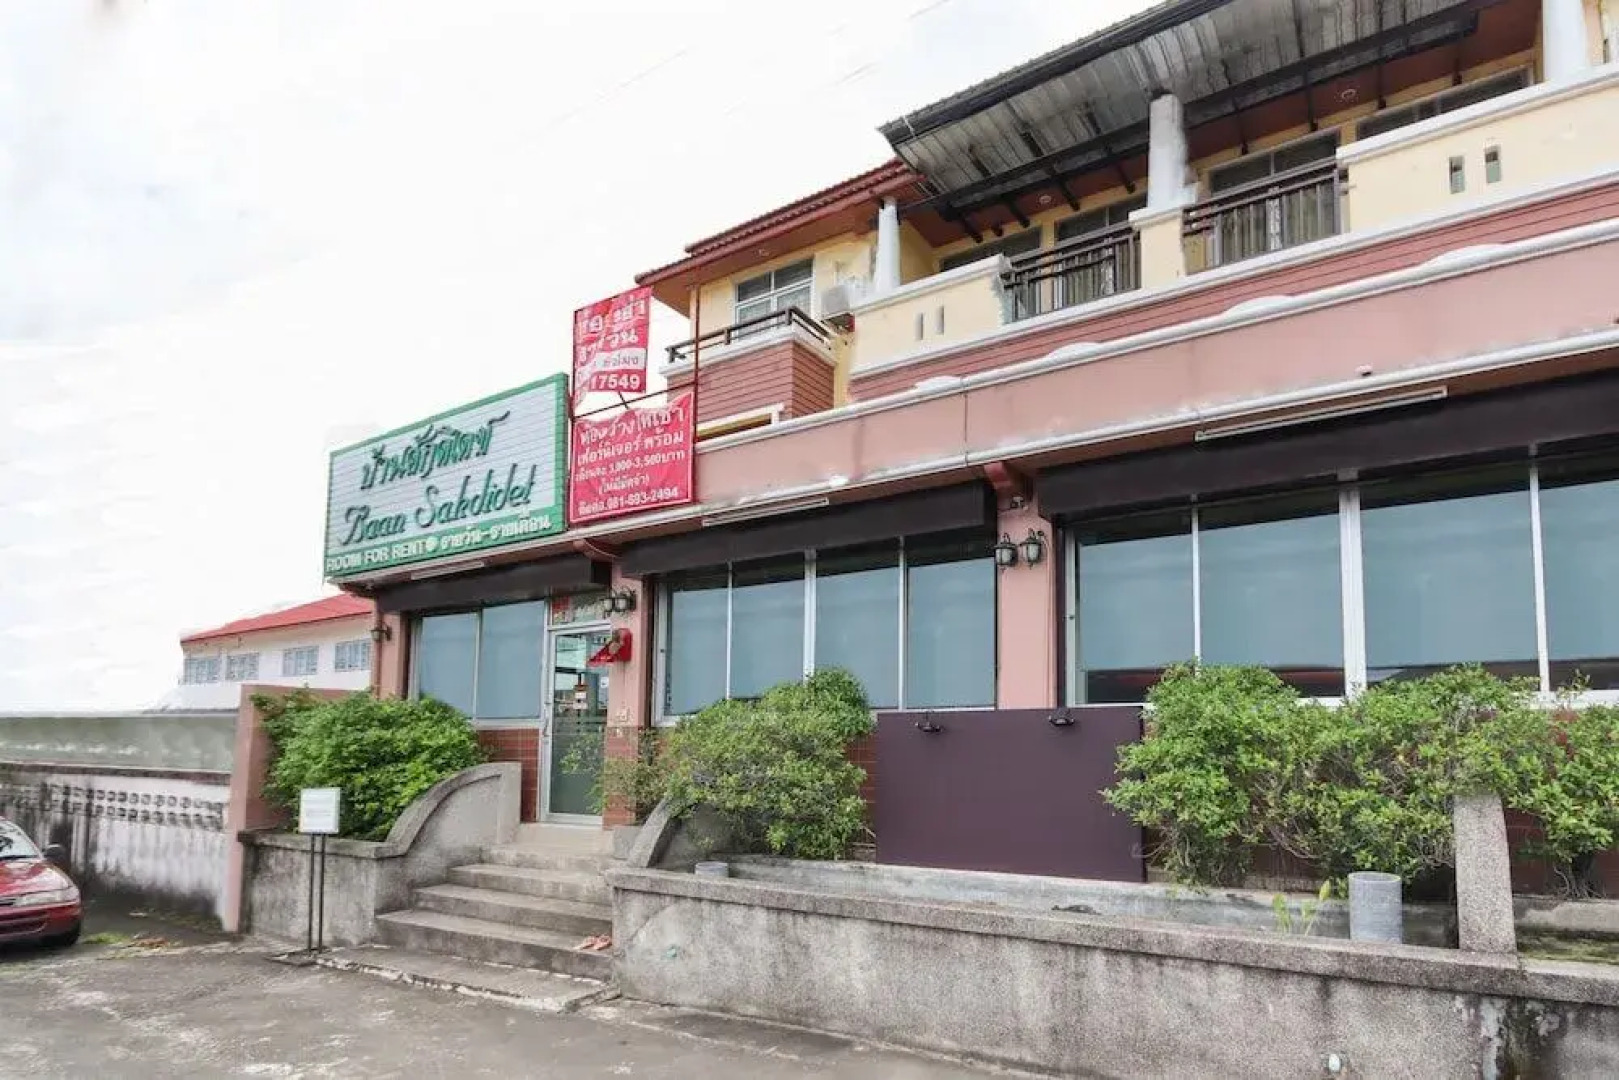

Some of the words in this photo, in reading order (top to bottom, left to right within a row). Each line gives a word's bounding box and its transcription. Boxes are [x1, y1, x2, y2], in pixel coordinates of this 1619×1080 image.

[338, 505, 406, 546] Baan
[415, 463, 537, 528] Sakdidet
[326, 554, 362, 571] ROOM
[364, 548, 390, 563] FOR
[391, 543, 427, 558] RENT
